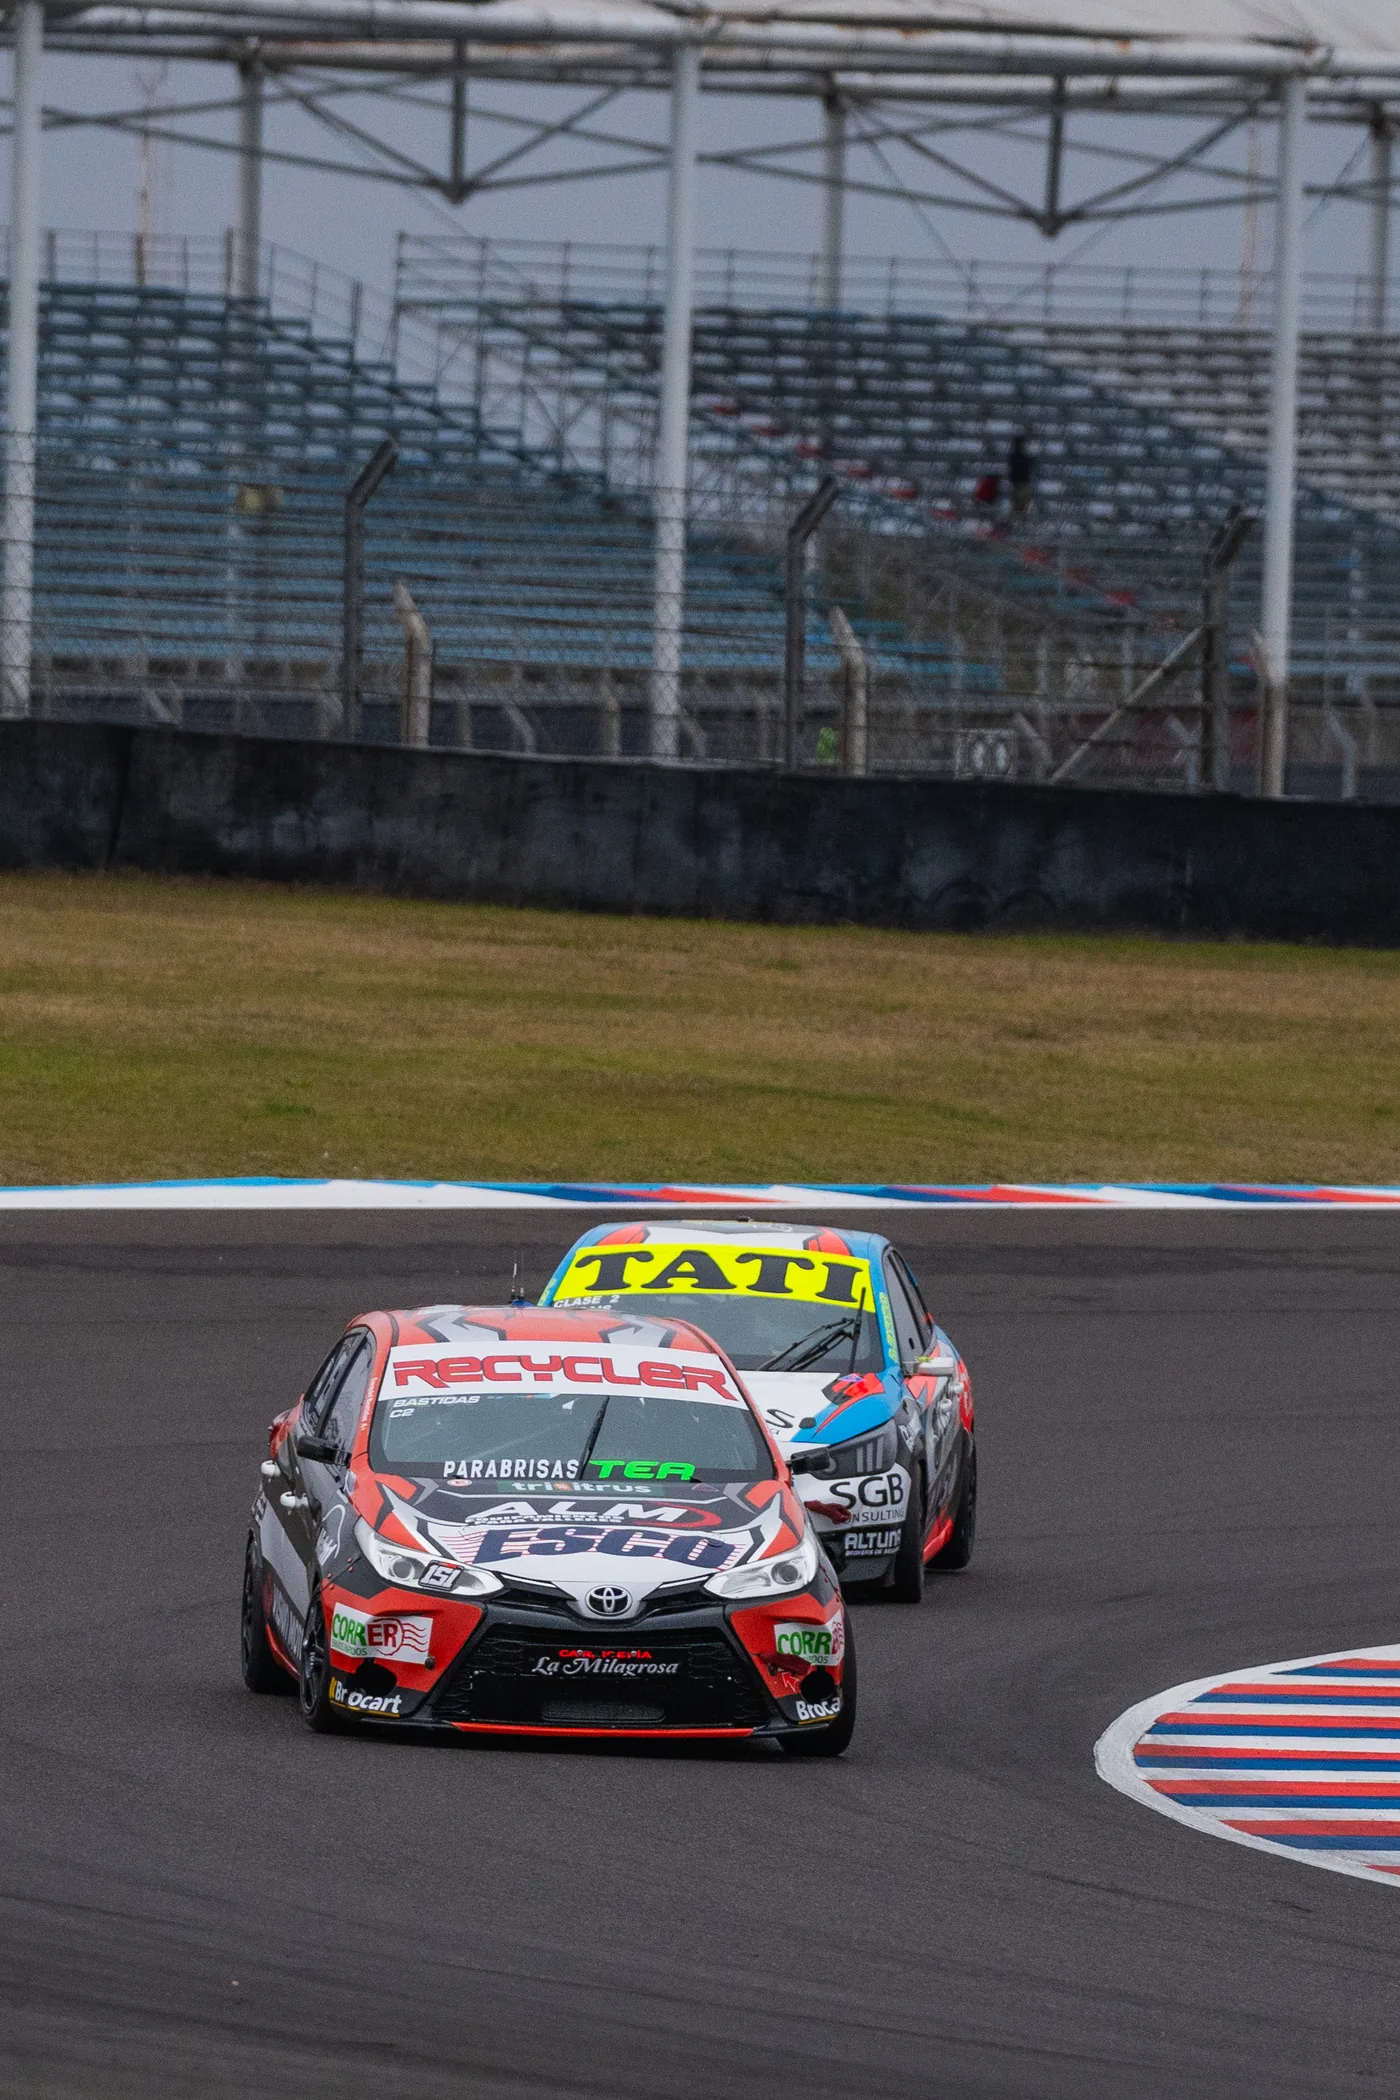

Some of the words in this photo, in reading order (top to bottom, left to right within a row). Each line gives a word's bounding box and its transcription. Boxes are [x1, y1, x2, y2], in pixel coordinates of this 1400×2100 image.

[575, 1250, 863, 1302] TATI
[554, 1295, 601, 1308] CLASE
[609, 1294, 621, 1304] 2
[389, 1408, 416, 1418] C2
[393, 1395, 481, 1409] BASTIDAS
[443, 1459, 580, 1479] PARABRISAS
[588, 1459, 696, 1481] TEA
[829, 1473, 904, 1509] SGB
[465, 1501, 689, 1523] ALM
[472, 1526, 738, 1570] ESCO
[420, 1564, 462, 1588] 151
[332, 1613, 398, 1648] CORRER
[532, 1657, 560, 1675] La
[563, 1658, 679, 1676] Milagrosa
[335, 1680, 402, 1714] Brocart
